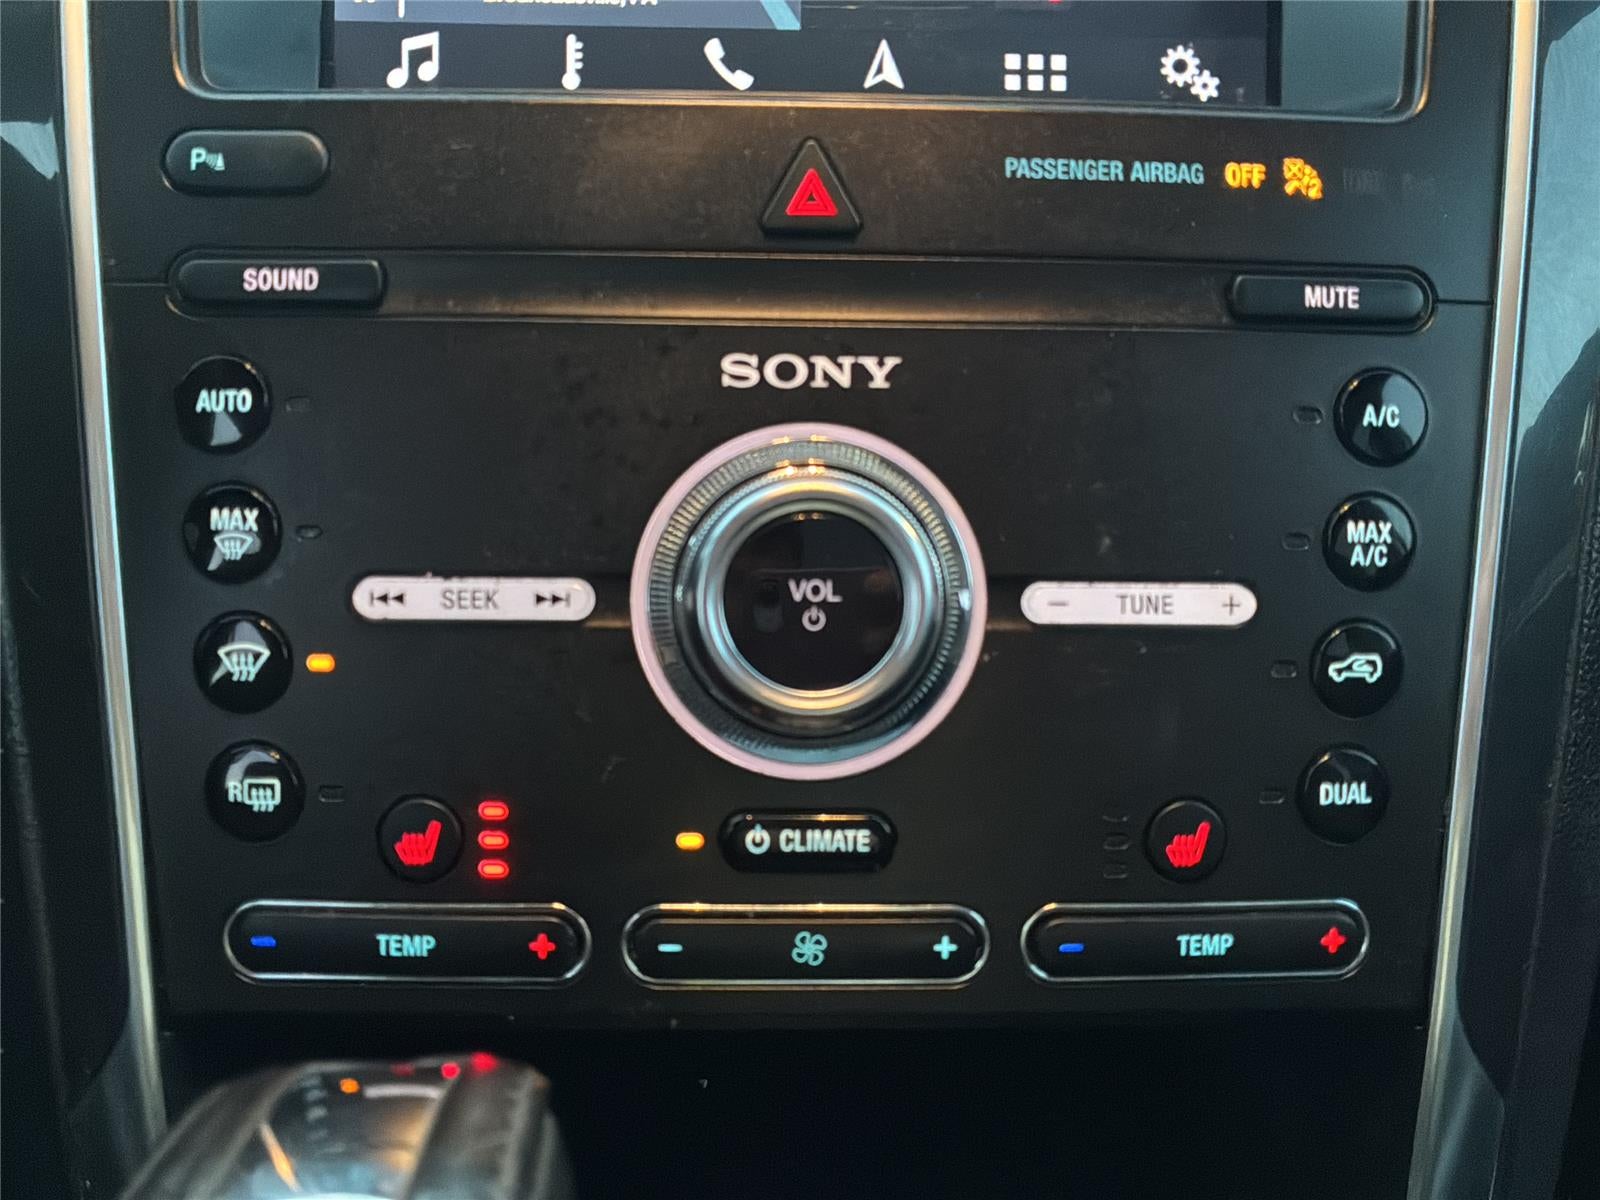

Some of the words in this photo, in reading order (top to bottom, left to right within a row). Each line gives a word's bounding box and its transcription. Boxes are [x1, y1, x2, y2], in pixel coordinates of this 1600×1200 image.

[1004, 157, 1124, 182] PASSENGER
[1131, 161, 1205, 185] AIRBAG
[1224, 161, 1266, 188] OFF
[243, 267, 319, 291] SOUND
[1304, 285, 1360, 309] MUTE
[720, 353, 902, 389] SONY
[195, 388, 253, 413] AUTO
[1363, 405, 1400, 427] A/C
[210, 508, 259, 532] MAX
[1347, 521, 1392, 544] MAX
[1350, 545, 1388, 567] A/C
[442, 590, 499, 610] SEEK
[788, 579, 842, 602] VOL
[1116, 595, 1174, 615] TUNE
[227, 780, 243, 802] R
[1319, 782, 1372, 806] DUAL
[779, 829, 871, 853] CLIMATE
[376, 934, 436, 957] TEMP
[1176, 933, 1234, 957] TEMP
